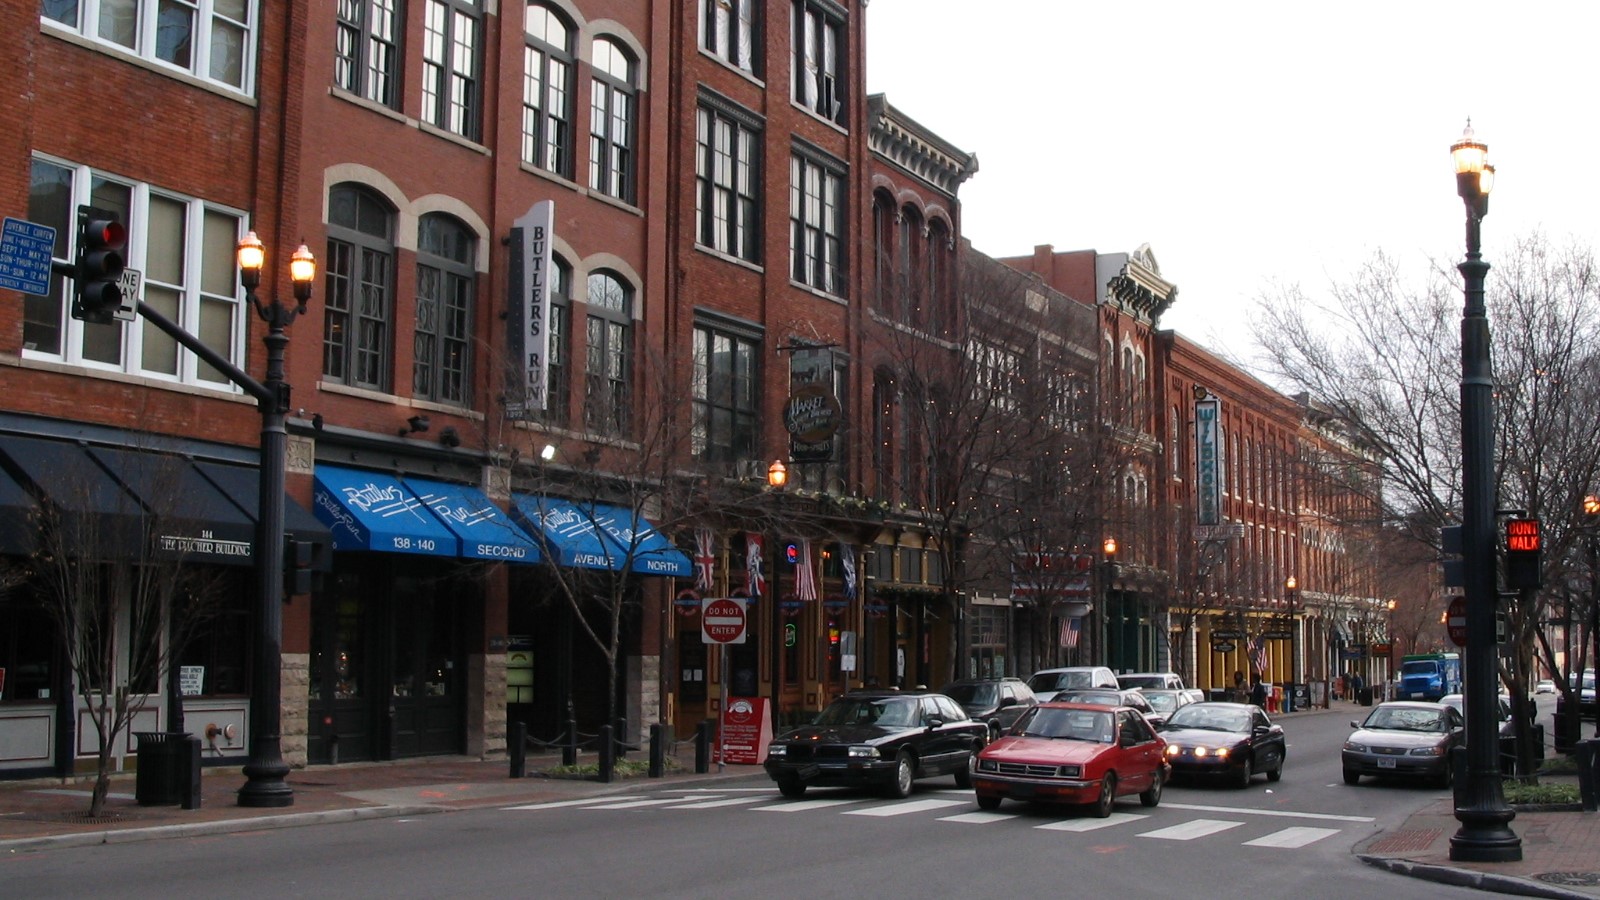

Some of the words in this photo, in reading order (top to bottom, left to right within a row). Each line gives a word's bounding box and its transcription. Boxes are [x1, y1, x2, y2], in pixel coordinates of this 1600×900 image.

[5, 222, 30, 235] JUVENILE
[2, 243, 18, 254] SEPT
[28, 250, 41, 260] MAY
[530, 226, 544, 336] BUTLERS
[120, 287, 136, 300] AY
[527, 353, 540, 400] RUN
[215, 543, 250, 556] BUILDING
[1510, 536, 1538, 550] WALK
[477, 544, 525, 558] SECOND
[574, 554, 615, 567] AVENUE
[647, 560, 678, 572] NORTH
[709, 607, 720, 615] DO
[723, 607, 739, 616] NOT
[711, 626, 736, 635] ENTER
